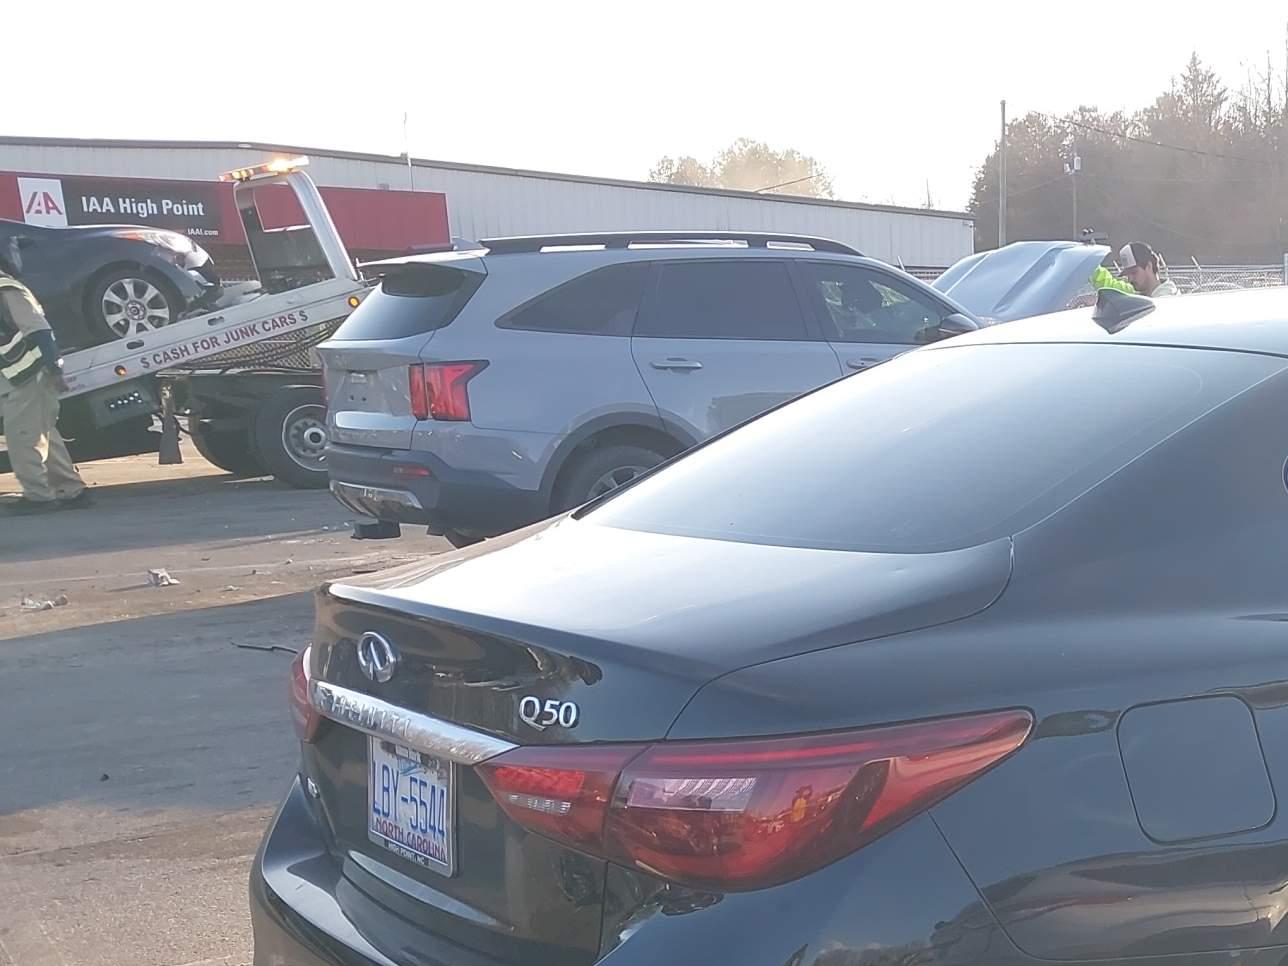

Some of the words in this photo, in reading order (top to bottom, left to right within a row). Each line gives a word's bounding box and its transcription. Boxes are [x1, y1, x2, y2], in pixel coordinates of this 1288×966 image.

[82, 196, 115, 213] IAA
[119, 199, 157, 217] High
[162, 200, 204, 215] Point
[153, 346, 190, 365] CASH
[192, 339, 221, 354] FOR
[223, 324, 261, 344] JUNK
[261, 313, 297, 332] CARS
[519, 696, 577, 731] Q50
[373, 760, 447, 839] LBY-5544
[375, 818, 405, 844] NORTH
[405, 832, 448, 863] CAROLINA
